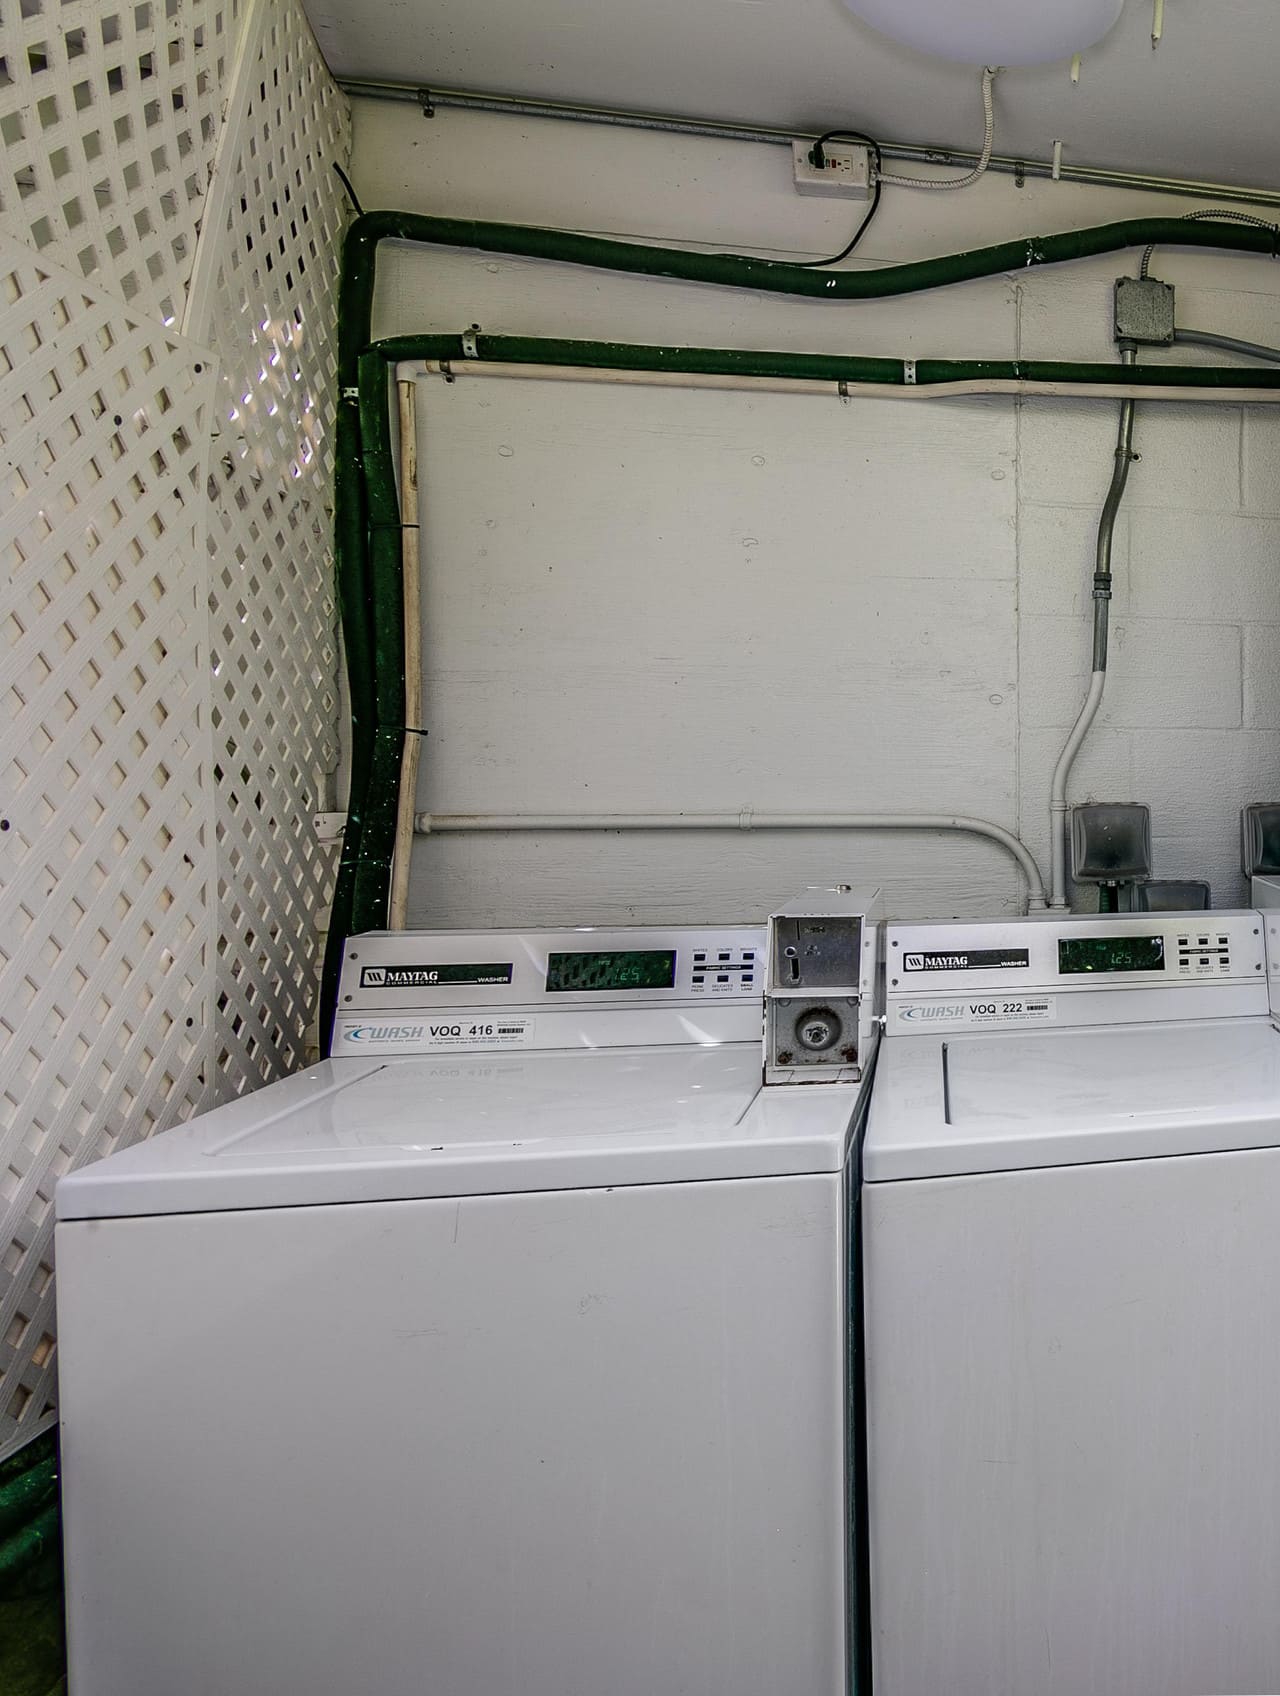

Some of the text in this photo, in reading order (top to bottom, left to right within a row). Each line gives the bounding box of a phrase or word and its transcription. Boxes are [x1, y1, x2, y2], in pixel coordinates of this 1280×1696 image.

[924, 956, 968, 966] MAYTAG
[386, 971, 439, 982] MAYTAG
[920, 1006, 965, 1018] WASH
[970, 1003, 1023, 1014] VOQ 222
[369, 1026, 425, 1039] WASH
[430, 1025, 493, 1037] VOQ 416
